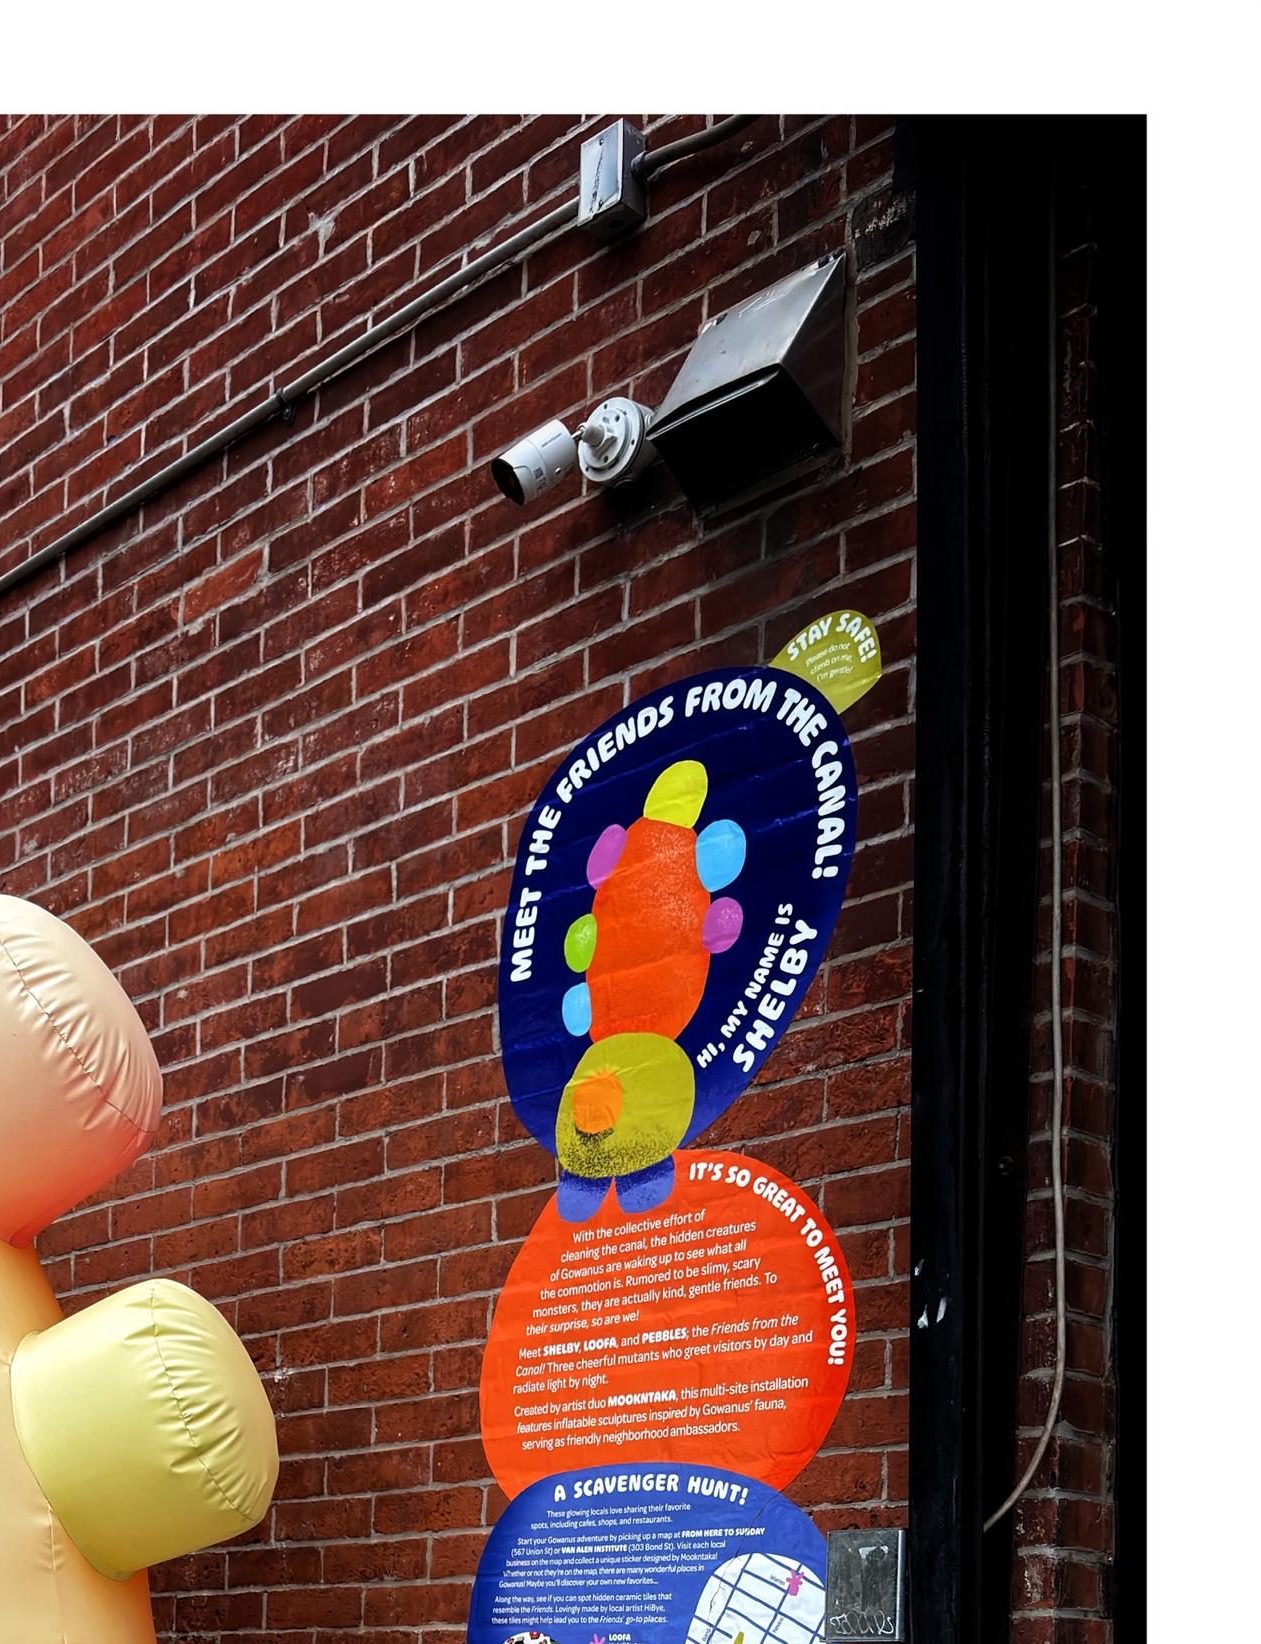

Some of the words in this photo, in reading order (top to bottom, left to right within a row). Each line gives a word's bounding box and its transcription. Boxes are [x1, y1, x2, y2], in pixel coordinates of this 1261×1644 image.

[787, 616, 832, 662] STAY
[836, 613, 877, 662] SAFE!
[685, 679, 777, 717] FROM
[777, 688, 829, 746] THE
[556, 696, 674, 803] FRIENDS
[812, 741, 846, 879] CANAL!
[525, 805, 561, 877] THE
[510, 887, 542, 982] MEET
[697, 1043, 725, 1068] HI,
[721, 1000, 748, 1038] MY
[745, 932, 785, 1000] NAME
[774, 903, 793, 925] IS
[732, 917, 819, 1072] SHELBY
[689, 1162, 724, 1181] IT'S
[725, 1166, 751, 1187] SO
[753, 1177, 805, 1222] GREAT
[561, 1248, 600, 1263] cleaning
[601, 1244, 618, 1256] the
[619, 1238, 648, 1253] canal,
[650, 1235, 668, 1248] the
[669, 1230, 704, 1244] hidden
[705, 1221, 756, 1238] creatures
[572, 1230, 595, 1243] With
[596, 1227, 613, 1239] the
[614, 1219, 662, 1236] collective
[663, 1213, 693, 1227] effort
[694, 1208, 706, 1222] of
[801, 1218, 823, 1247] TO
[540, 1288, 556, 1300] the
[557, 1280, 611, 1297] commotion
[613, 1278, 623, 1289] is.
[626, 1269, 671, 1287] Rumored
[673, 1269, 684, 1280] to
[686, 1266, 700, 1278] be
[701, 1262, 730, 1275] slimy,
[732, 1257, 761, 1271] scary
[550, 1269, 560, 1282] of
[560, 1265, 604, 1280] Gowanus
[606, 1262, 623, 1273] are
[624, 1255, 658, 1269] waking
[659, 1254, 673, 1265] up
[674, 1251, 685, 1262] to
[686, 1248, 705, 1260] see
[707, 1243, 733, 1256] what
[734, 1238, 747, 1252] all
[814, 1246, 844, 1303] MEET
[532, 1304, 578, 1318] monsters,
[581, 1300, 603, 1311] they
[604, 1297, 620, 1308] are
[621, 1289, 661, 1305] actually
[662, 1285, 686, 1299] kind,
[688, 1281, 721, 1299] gentle
[723, 1274, 761, 1291] friends.
[764, 1272, 778, 1284] To
[519, 1347, 542, 1359] Meet
[543, 1341, 581, 1356] SHELBY,
[583, 1336, 619, 1351] LOOFA,
[621, 1333, 640, 1347] and
[641, 1327, 689, 1344] PEBBLES;
[691, 1325, 709, 1338] the
[711, 1319, 750, 1335] Friends
[752, 1317, 778, 1330] from
[780, 1313, 799, 1327] the
[526, 1323, 548, 1336] their
[549, 1319, 589, 1333] surprise,
[591, 1317, 604, 1327] so
[603, 1314, 621, 1325] are
[622, 1310, 640, 1323] we!
[828, 1309, 847, 1365] YOU!
[515, 1363, 546, 1377] Canal!
[547, 1362, 575, 1372] Three
[576, 1354, 616, 1370] cheerful
[618, 1351, 660, 1365] mutants
[661, 1347, 683, 1360] who
[683, 1344, 711, 1360] greet
[713, 1340, 752, 1353] visitors
[754, 1337, 768, 1351] by
[769, 1335, 790, 1348] day
[791, 1329, 813, 1344] and
[513, 1381, 546, 1394] radiate
[547, 1378, 567, 1393] light
[568, 1377, 580, 1389] by
[582, 1374, 609, 1389] night.
[514, 1402, 549, 1417] Created
[549, 1402, 561, 1415] by
[562, 1399, 586, 1412] artist
[587, 1397, 607, 1409] duo
[607, 1389, 678, 1407] MOOKNTAKA,
[681, 1387, 699, 1400] this
[700, 1382, 749, 1397] multi-site
[750, 1377, 809, 1392] installation
[517, 1422, 552, 1434] features
[553, 1416, 597, 1430] inflatable
[598, 1413, 647, 1426] sculptures
[649, 1406, 688, 1422] inspired
[689, 1406, 701, 1419] by
[702, 1400, 753, 1416] Gowanus'
[754, 1398, 787, 1411] fauna,
[522, 1438, 554, 1451] serving
[554, 1438, 566, 1447] as
[566, 1433, 602, 1446] friendly
[602, 1426, 669, 1445] neighborhood
[669, 1421, 740, 1437] ambassadors.
[547, 1510, 565, 1518] These
[566, 1509, 590, 1519] glowing
[590, 1507, 609, 1516] locals
[624, 1505, 647, 1515] sharing
[648, 1504, 664, 1512] their
[665, 1503, 691, 1511] favorite
[554, 1485, 566, 1502] A
[574, 1474, 679, 1498] SCAVENGER
[687, 1476, 748, 1505] HUNT!
[550, 1520, 578, 1529] including
[619, 1517, 632, 1525] and
[608, 1633, 632, 1642] LOOFA
